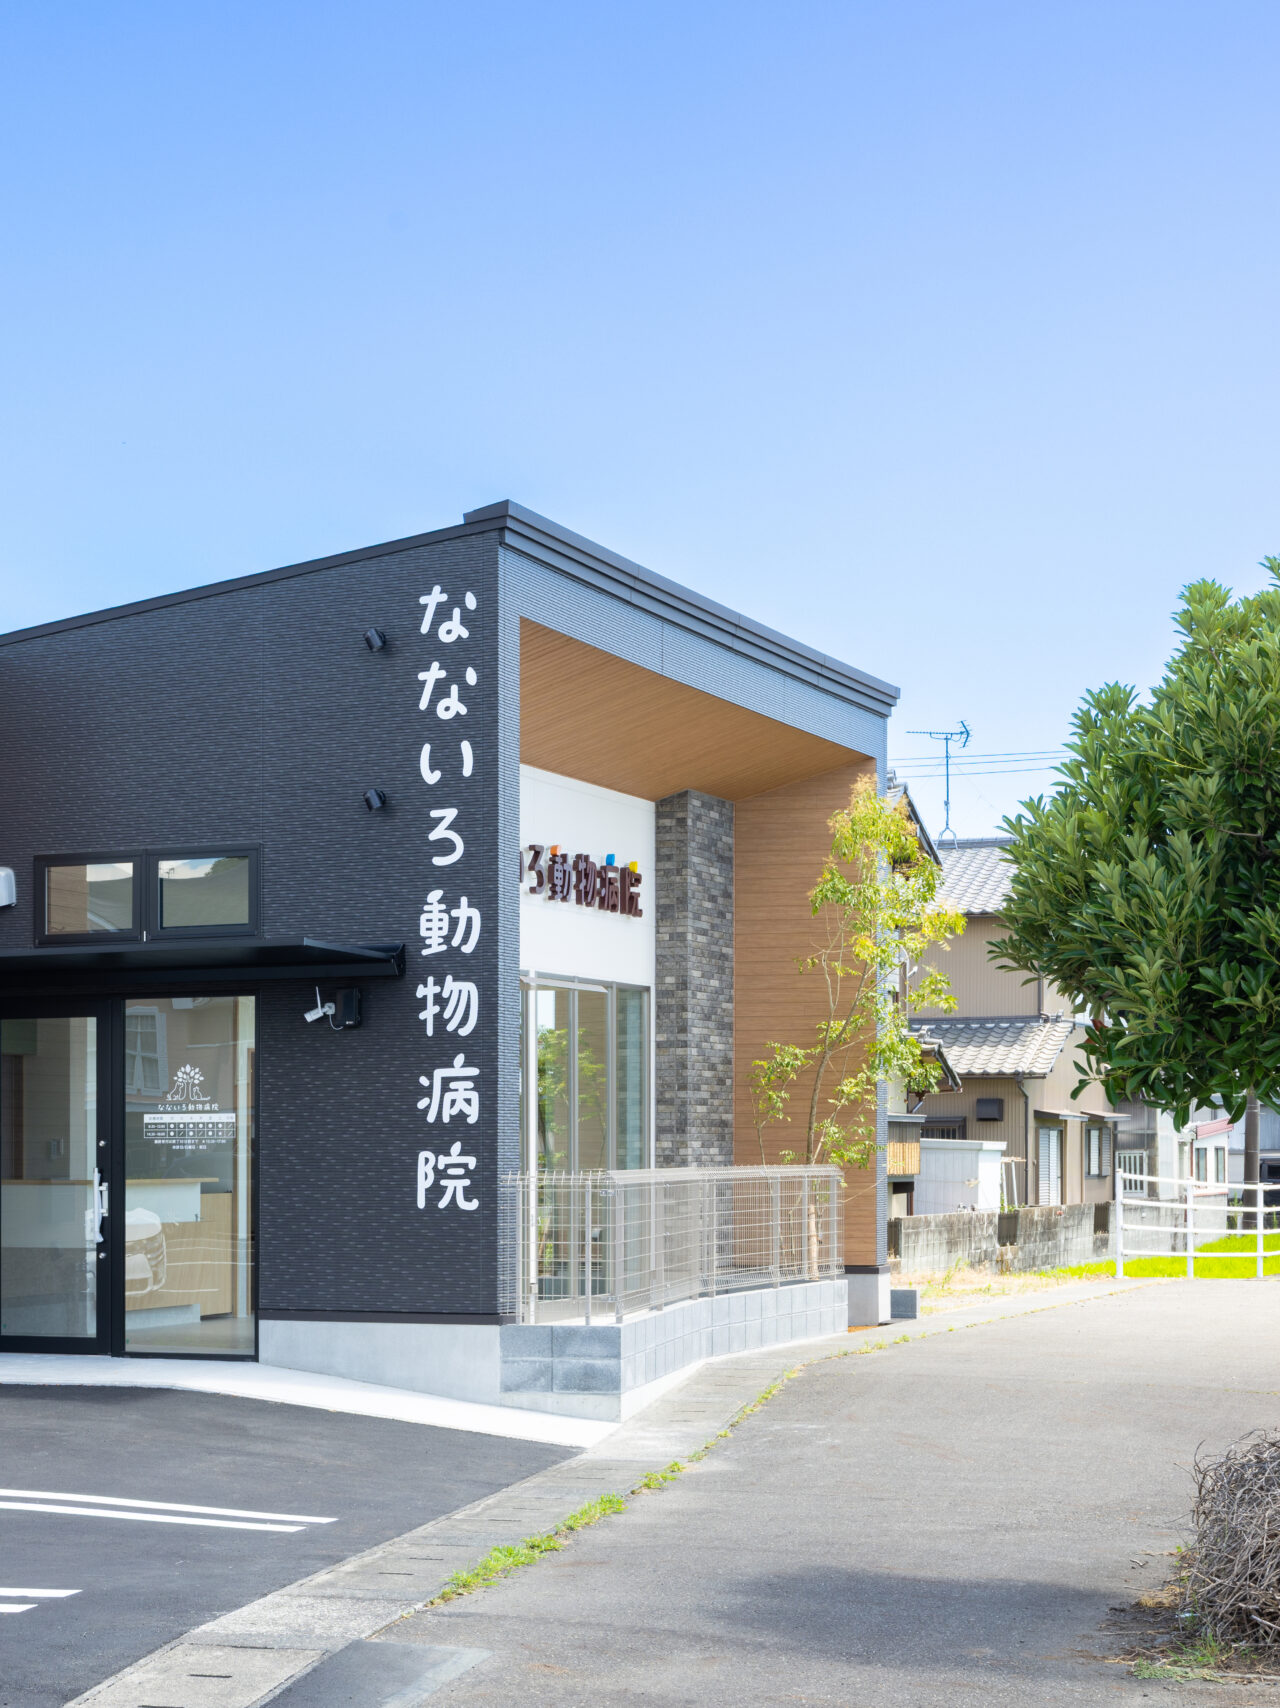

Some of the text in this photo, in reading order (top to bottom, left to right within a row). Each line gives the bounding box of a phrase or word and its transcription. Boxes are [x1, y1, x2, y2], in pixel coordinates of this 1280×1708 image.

[416, 585, 481, 1211] なないろ動物病院
[158, 1103, 219, 1111] なないろ動物病院
